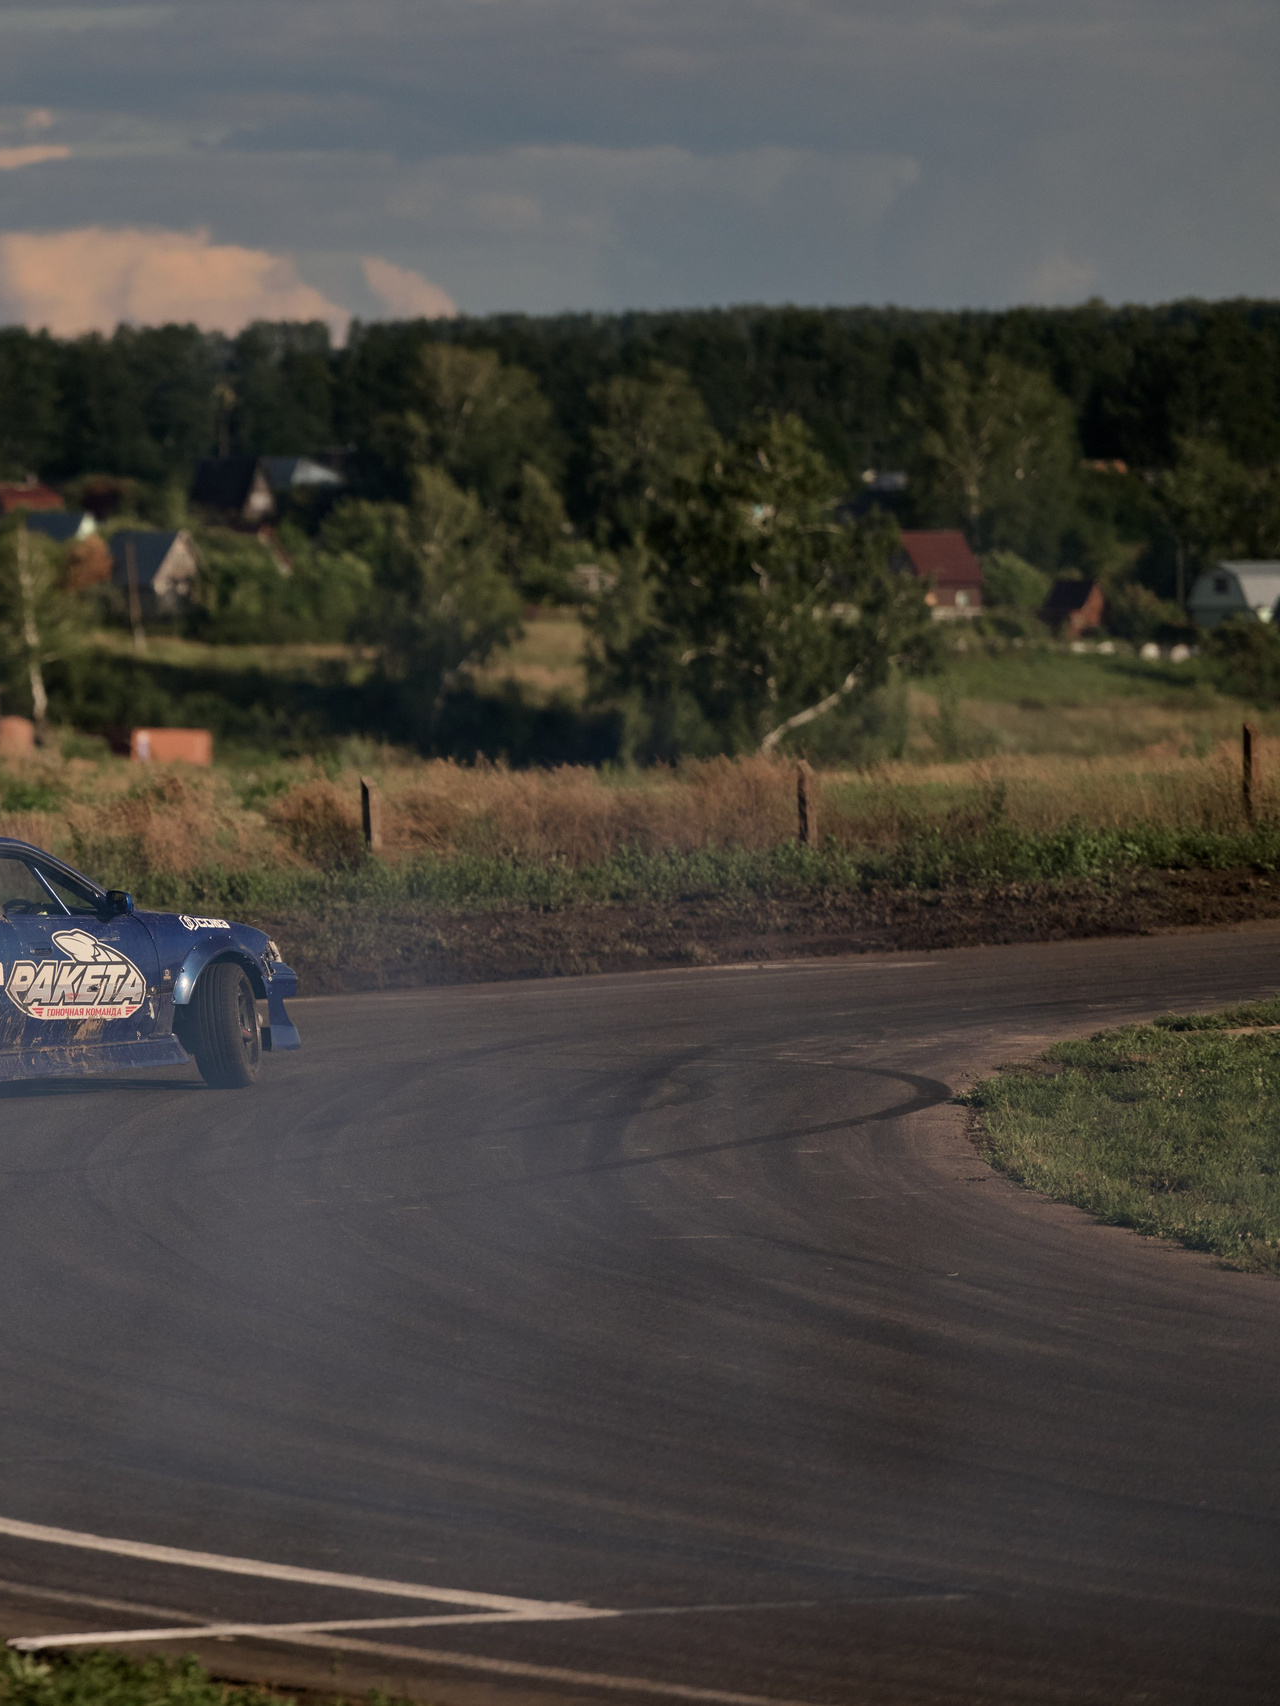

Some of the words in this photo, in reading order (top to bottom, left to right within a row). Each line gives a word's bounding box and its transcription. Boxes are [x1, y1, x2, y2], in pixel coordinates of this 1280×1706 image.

[8, 962, 146, 1005] РАКЕТА
[46, 1007, 84, 1017] ГОНОЧНАЯ
[85, 1007, 122, 1016] КОМАНДА
